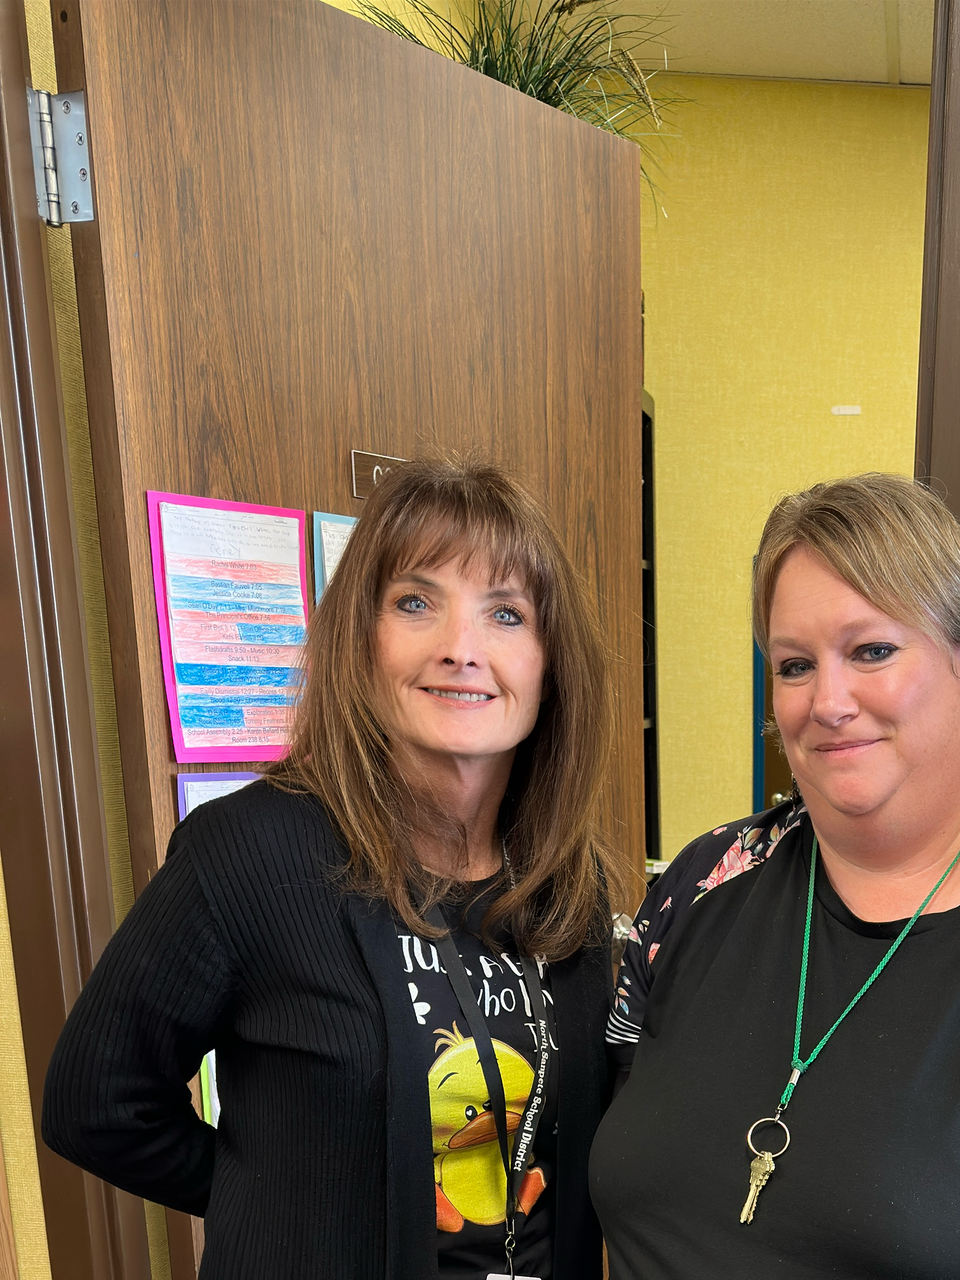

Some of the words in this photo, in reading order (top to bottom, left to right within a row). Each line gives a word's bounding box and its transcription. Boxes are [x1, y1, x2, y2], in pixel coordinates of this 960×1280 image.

[538, 1019, 549, 1051] North
[535, 1051, 549, 1095] Sanpete
[523, 1095, 542, 1132] School
[513, 1132, 533, 1172] District
